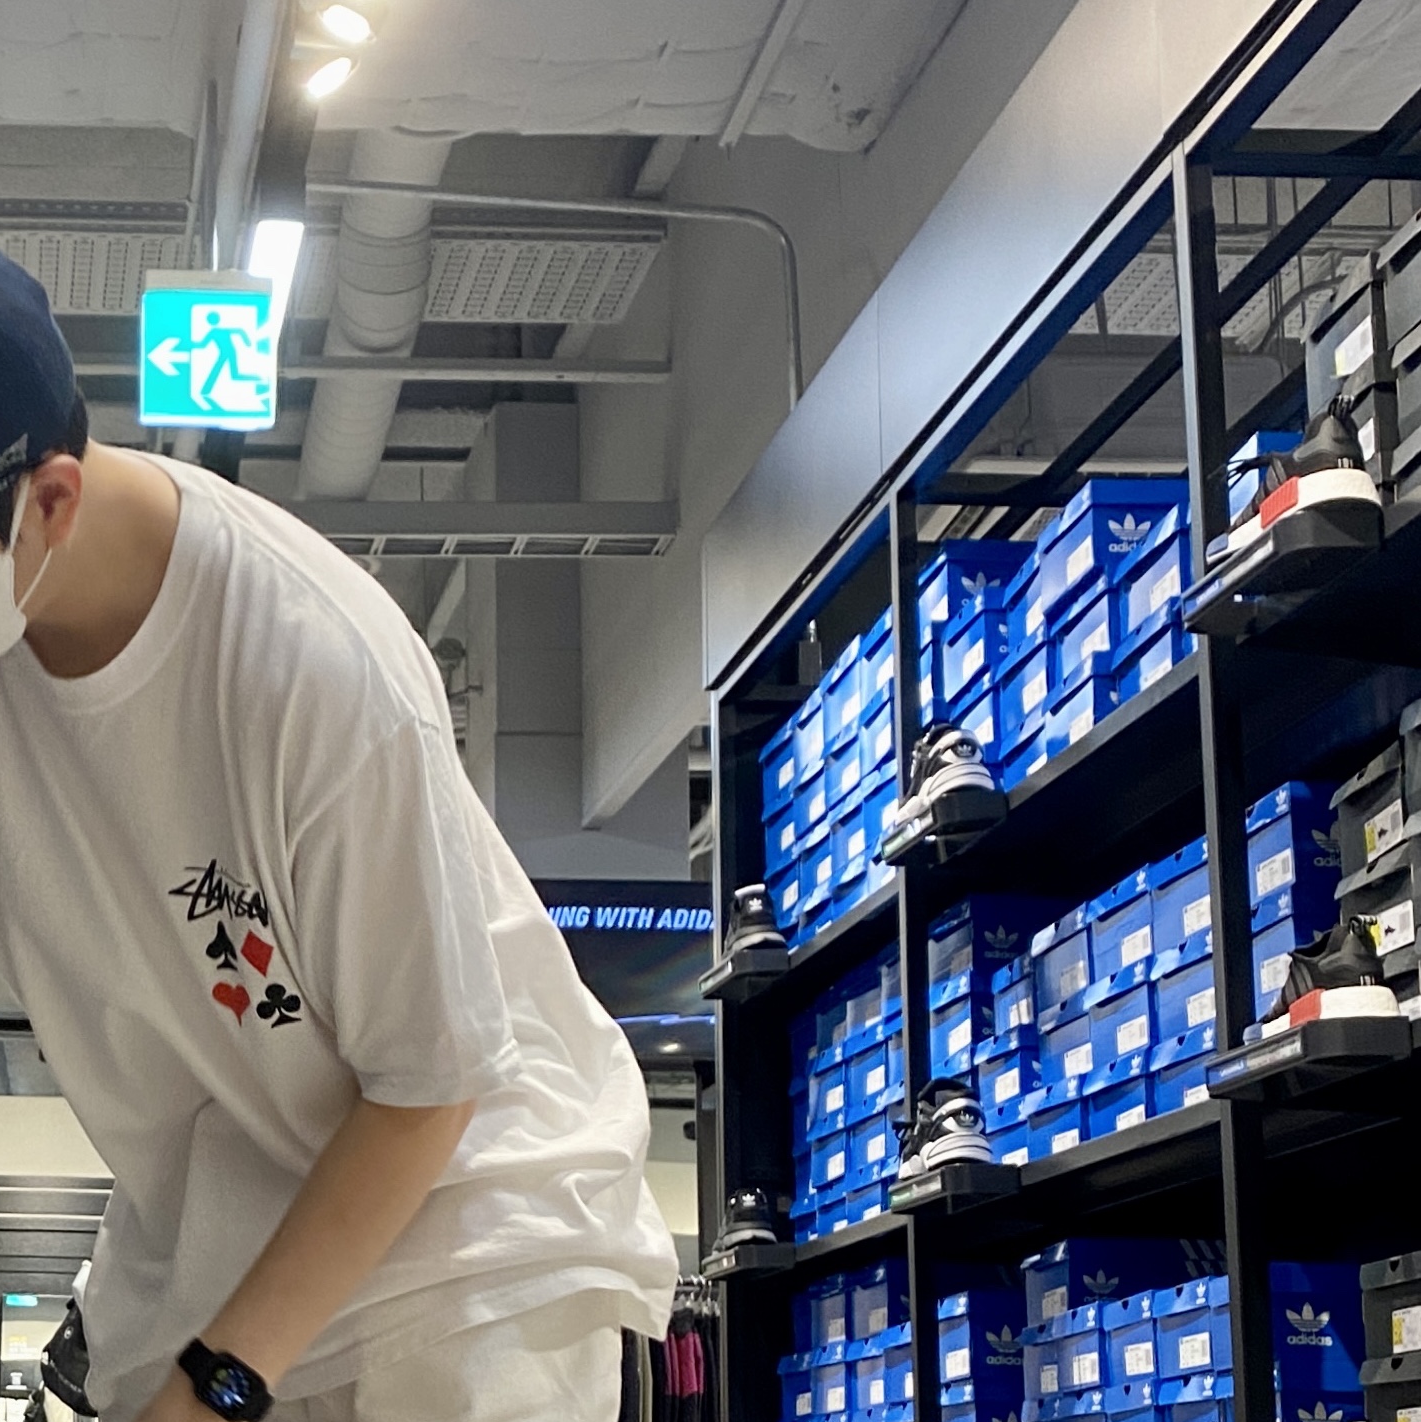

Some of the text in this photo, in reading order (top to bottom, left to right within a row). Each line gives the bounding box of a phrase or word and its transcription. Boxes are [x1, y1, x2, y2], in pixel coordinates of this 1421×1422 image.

[595, 907, 655, 930] WITH
[656, 908, 716, 931] ADID
[1287, 1334, 1333, 1346] adidas
